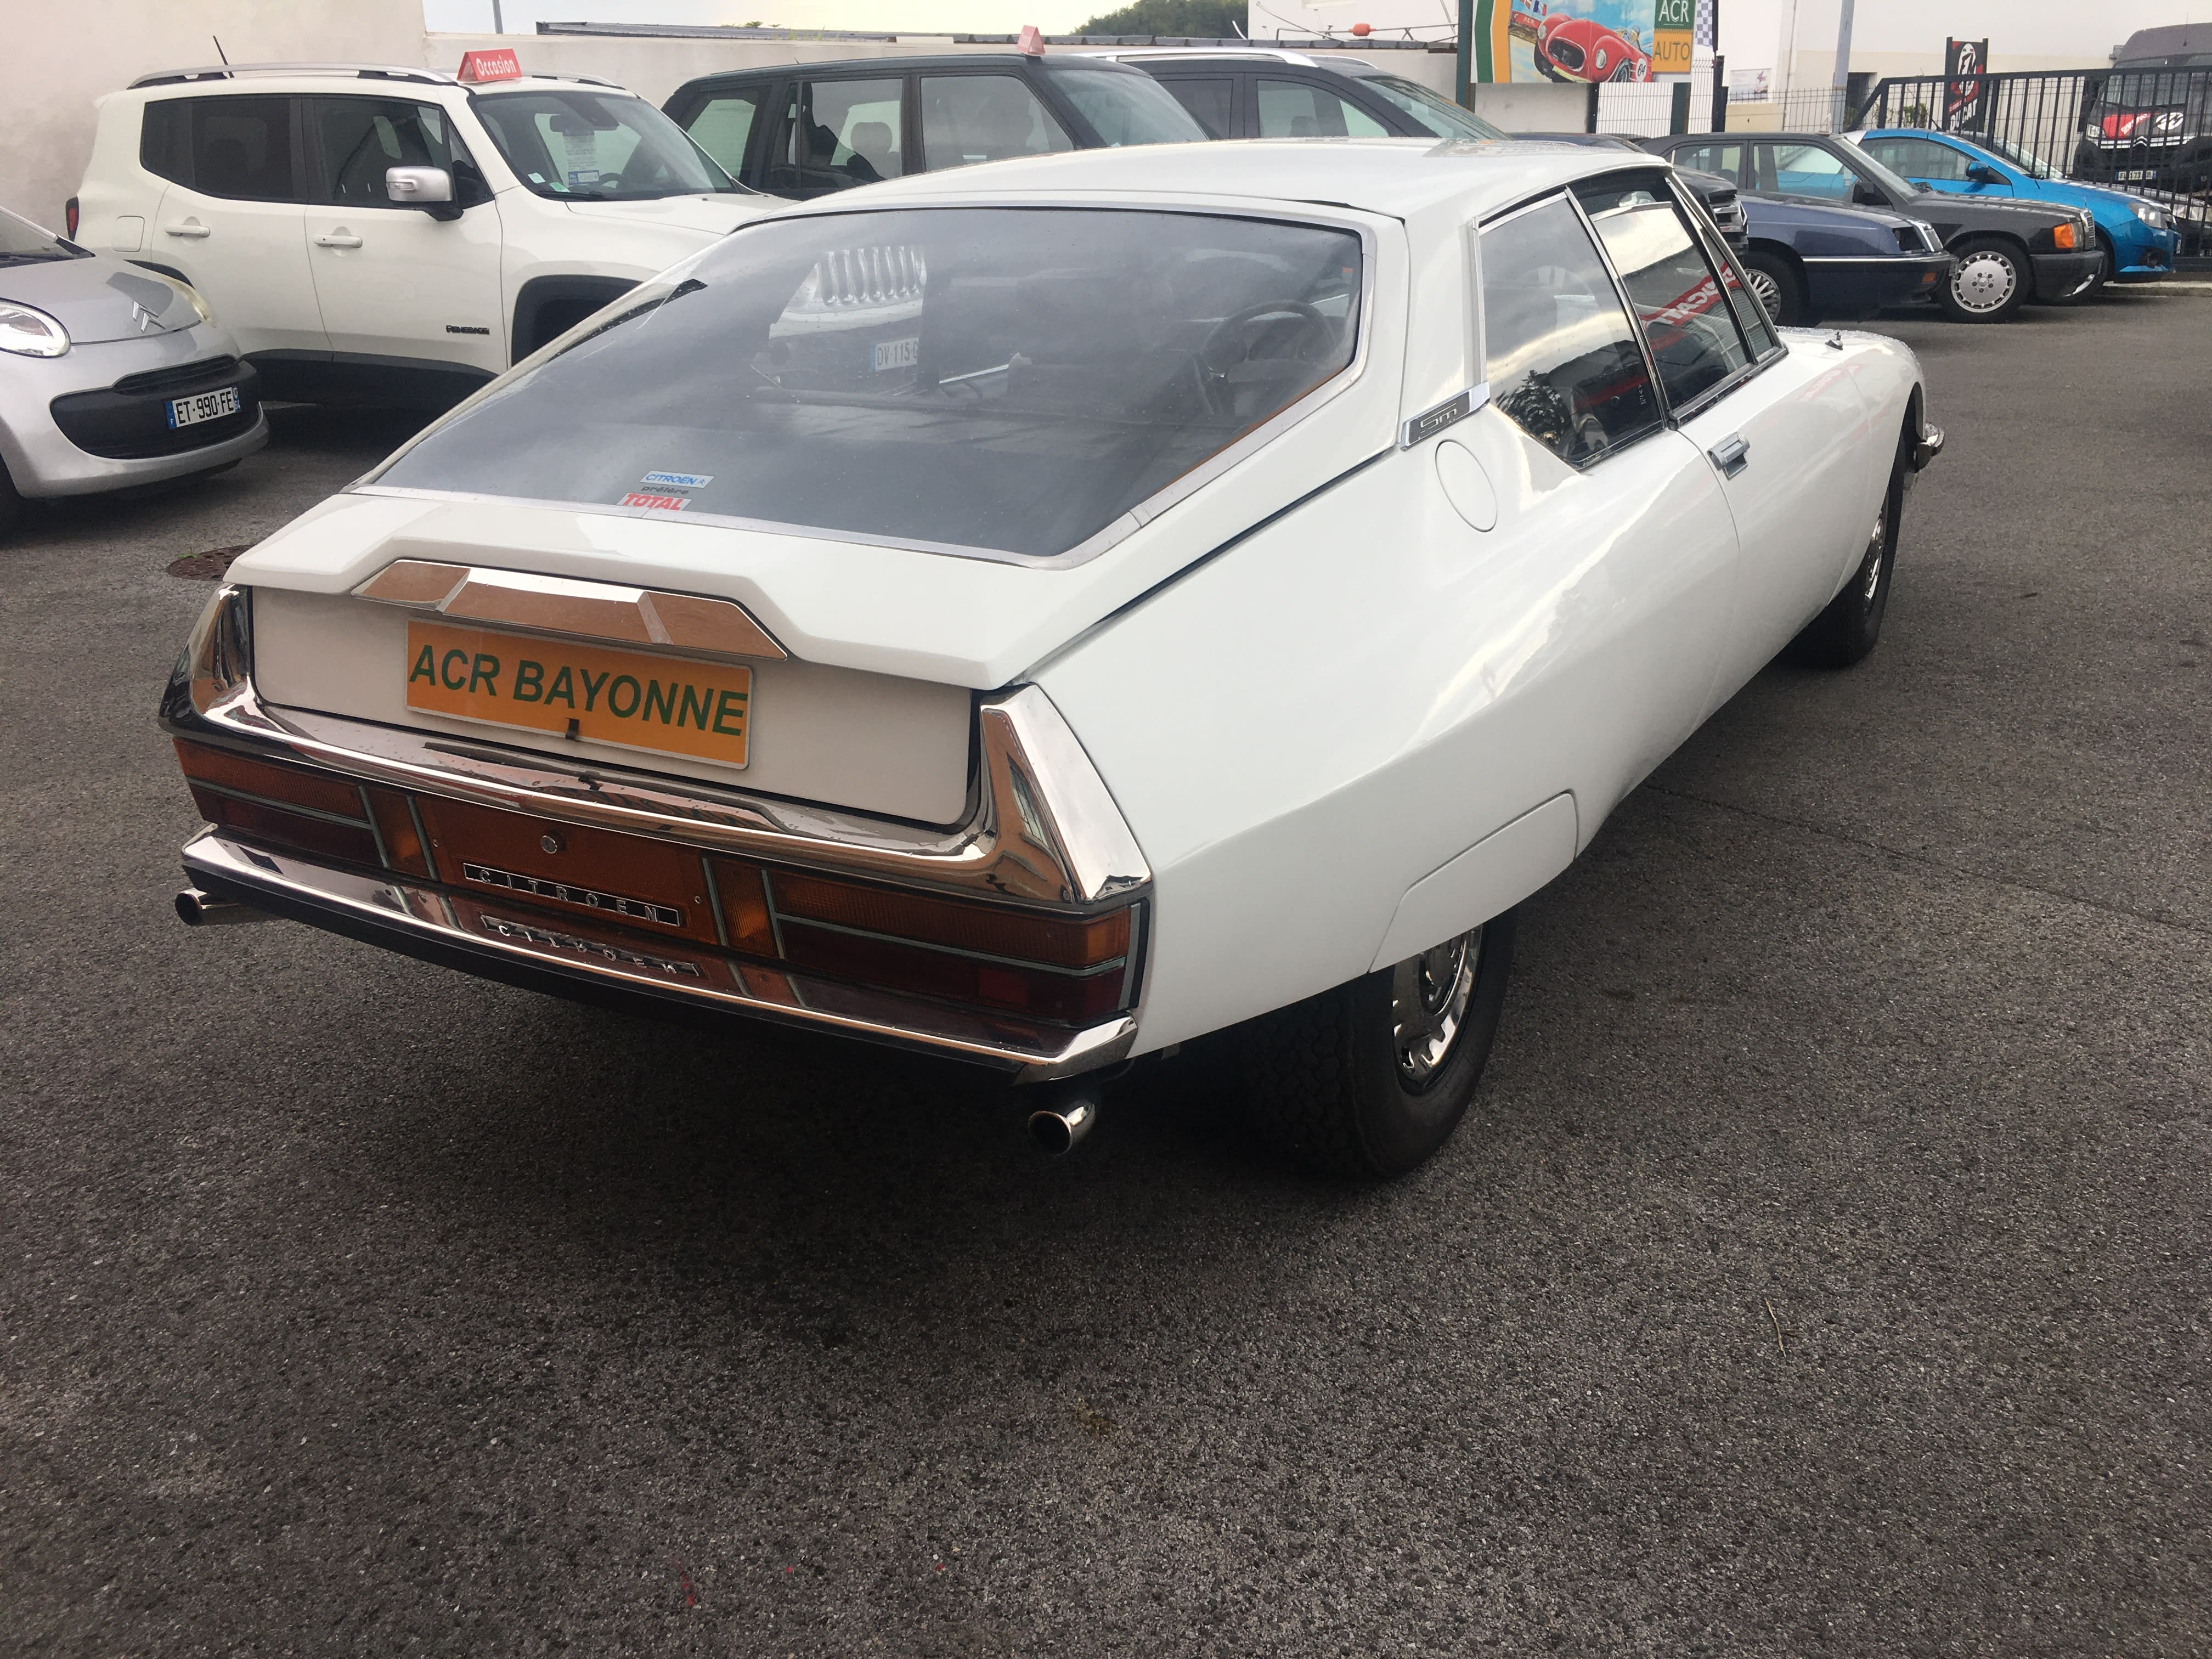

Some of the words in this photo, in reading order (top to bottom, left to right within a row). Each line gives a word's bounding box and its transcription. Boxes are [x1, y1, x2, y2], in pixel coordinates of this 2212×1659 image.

[1658, 0, 1690, 22] ACR
[1652, 41, 1690, 61] AUTO
[476, 54, 517, 76] Occasion
[176, 391, 234, 424] ET-990-FE
[646, 473, 698, 485] CITROËN
[623, 493, 684, 511] TOTAL
[409, 645, 500, 696] ACR
[513, 659, 749, 737] BAYONNE
[479, 869, 659, 922] CITROEN
